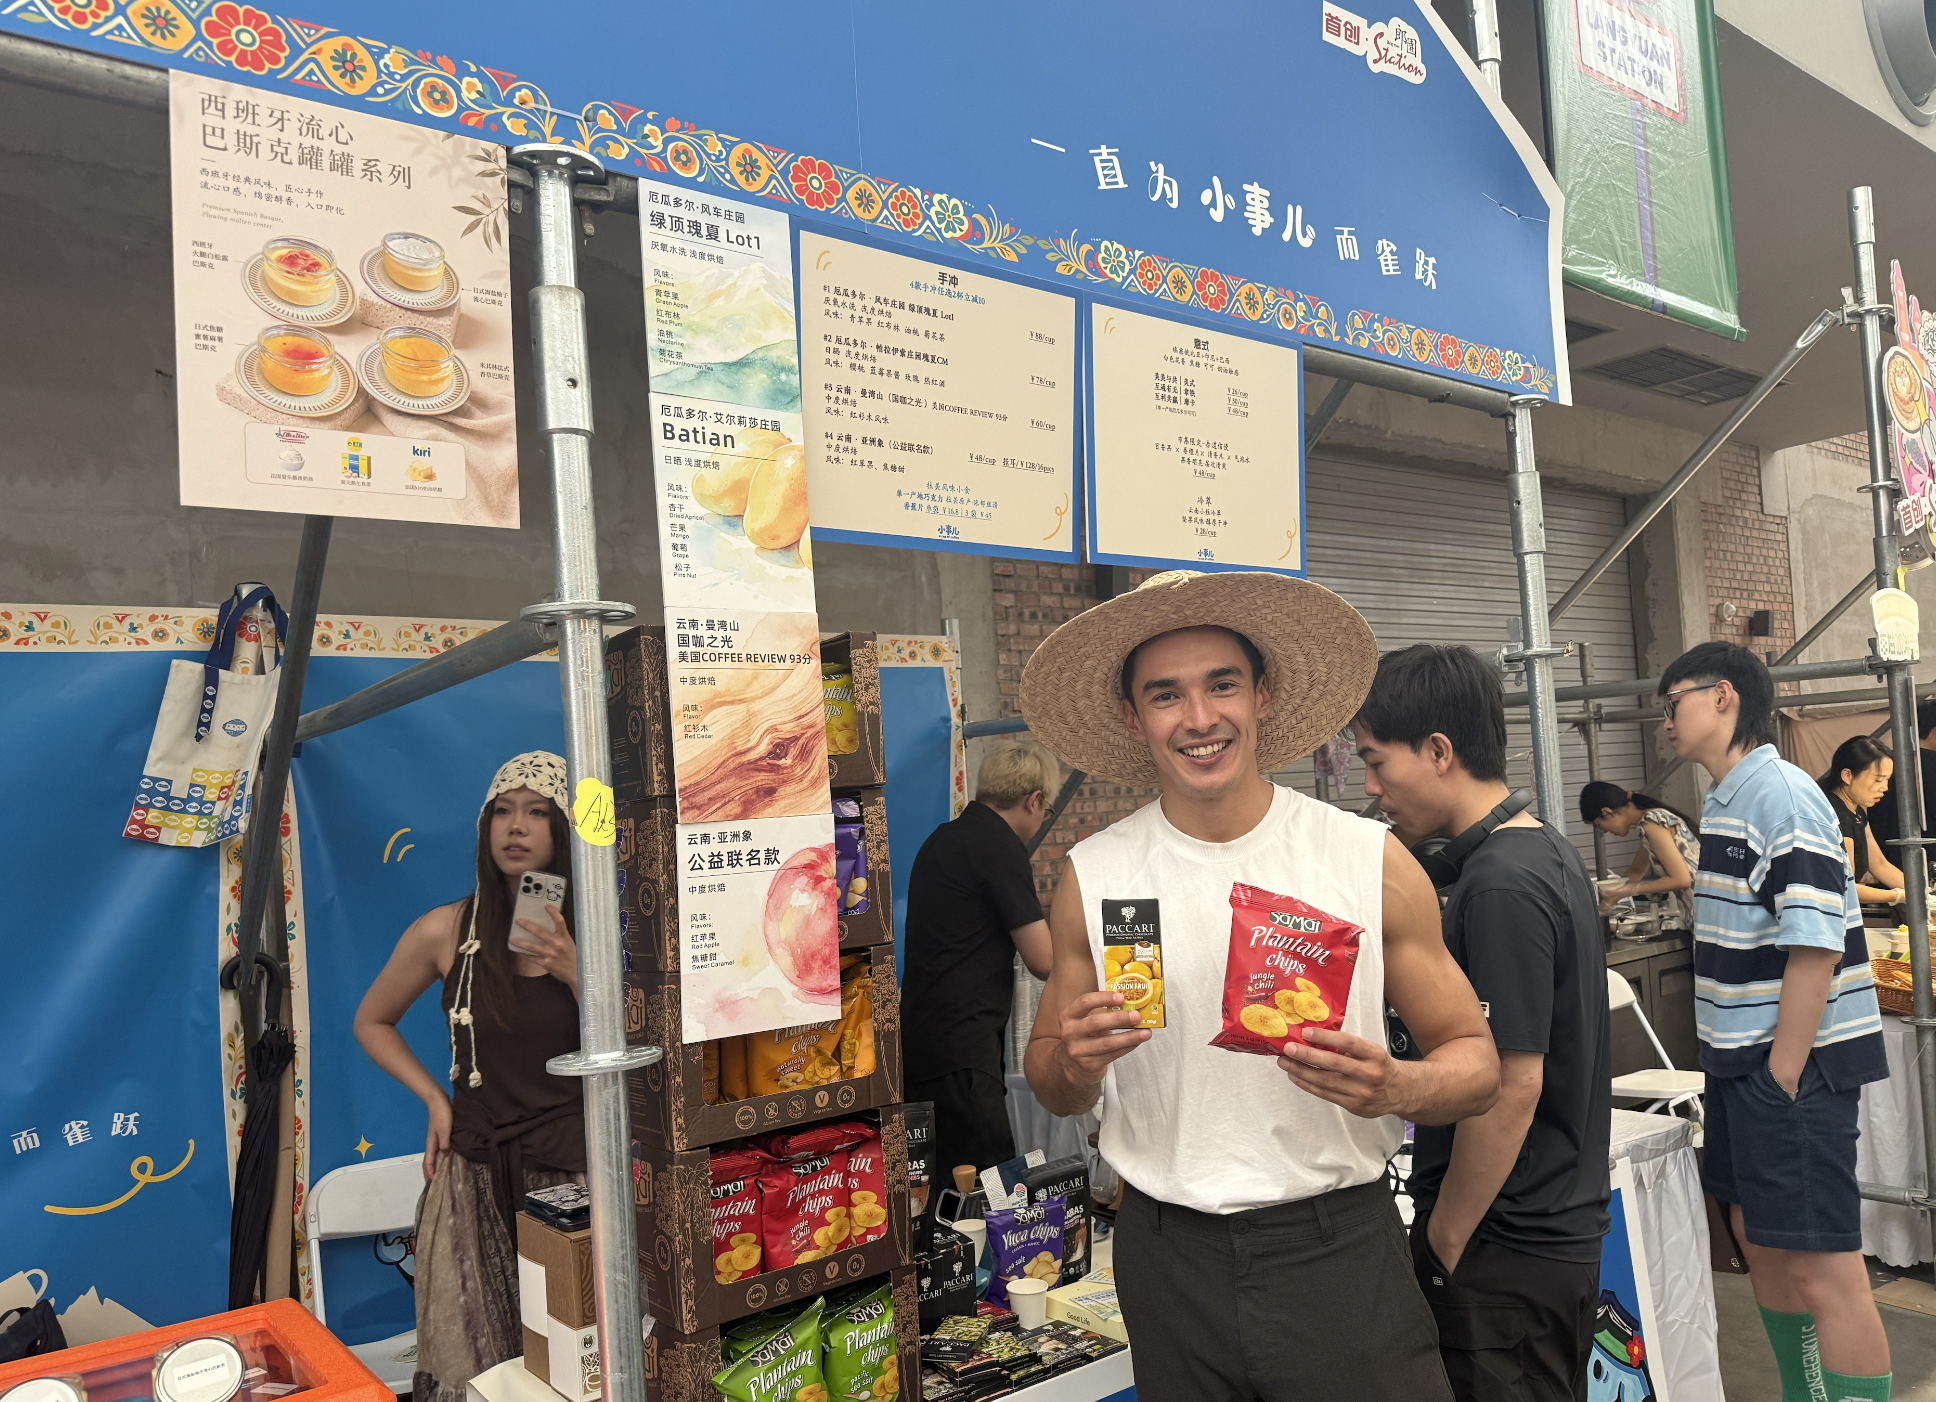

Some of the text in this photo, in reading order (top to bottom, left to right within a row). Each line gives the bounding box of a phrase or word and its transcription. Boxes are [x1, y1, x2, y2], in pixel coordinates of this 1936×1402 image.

[1372, 31, 1424, 77] Station
[1597, 39, 1665, 95] STATION
[199, 91, 354, 146] 西班牙流心
[202, 123, 412, 190] 巴斯克罐罐系列
[232, 207, 258, 219] Spanish
[648, 190, 745, 224] 厄瓜多尔·风车庄园
[202, 211, 252, 226] Flowing molten
[649, 209, 761, 250] 绿顶瑰夏 Lot1
[191, 239, 214, 250] 西班牙
[651, 240, 725, 265] 厌氧水洗 浅度烘焙
[192, 260, 215, 270] 巴斯克
[937, 271, 959, 288] 手冲
[654, 288, 680, 301] 青苹果
[655, 297, 689, 310] Green Apple
[823, 296, 893, 319] 厌氧水洗 浅度烘焙
[908, 303, 939, 318] 绿顶瑰夏
[655, 308, 681, 320] 红布林
[656, 317, 683, 328] Red Plum
[194, 342, 218, 353] 巴斯克
[658, 348, 684, 361] 菊花茶
[845, 348, 877, 363] 浅度烘焙
[825, 393, 858, 408] 中度烘焙
[660, 404, 781, 433] 厄瓜多尔·艾尔莉莎庄园
[969, 408, 994, 419] REVIEW
[662, 422, 736, 449] Batian
[412, 445, 431, 458] kiri
[825, 442, 858, 456] 中度烘焙
[665, 455, 721, 471] 日晒 浅度烘焙
[668, 503, 685, 513] 杏干
[1900, 496, 1924, 532] 首创
[669, 512, 684, 520] Dried
[669, 523, 687, 533] 芒果
[937, 524, 960, 536] 小事儿
[670, 532, 690, 540] Mango
[671, 543, 688, 553] 葡萄
[672, 552, 690, 560] Grape
[674, 563, 691, 572] 松子
[675, 617, 740, 632] 云南·曼湾山
[677, 633, 734, 649] 国咖之光
[678, 651, 812, 665] 美国COFFEE REVIEW 93分
[679, 675, 716, 686] 中度烘焙
[683, 723, 709, 733] 红杉木
[686, 829, 753, 846] 云南·亚洲象
[687, 847, 781, 872] 公益联名款
[688, 882, 726, 895] 中度烘焙
[1105, 923, 1154, 934] PACCARI
[690, 932, 717, 944] 红苹果
[703, 941, 720, 950] Apple
[1249, 925, 1333, 967] Plantain
[691, 952, 717, 964] 焦糖甜
[1265, 950, 1307, 978] chips
[691, 960, 735, 971] Sweet Caramel
[1250, 971, 1276, 985] jungle
[1254, 979, 1275, 990] chili
[1110, 982, 1151, 990] PASSION FRUIT
[10, 1111, 141, 1155] 而雀跃
[786, 1170, 845, 1209] Plantain
[1047, 1176, 1085, 1196] PACCARI
[798, 1195, 834, 1217] chips
[789, 1218, 809, 1234] jungle
[795, 1226, 811, 1240] chili
[1001, 1221, 1061, 1251] Yuca Chips
[1015, 1255, 1026, 1266] salt
[943, 1272, 974, 1289] PACCARI
[1066, 1311, 1091, 1326] Good Life
[861, 1342, 890, 1367] chips
[746, 1347, 816, 1402] Plantain
[850, 1370, 870, 1386] pacific
[850, 1383, 861, 1393] sea
